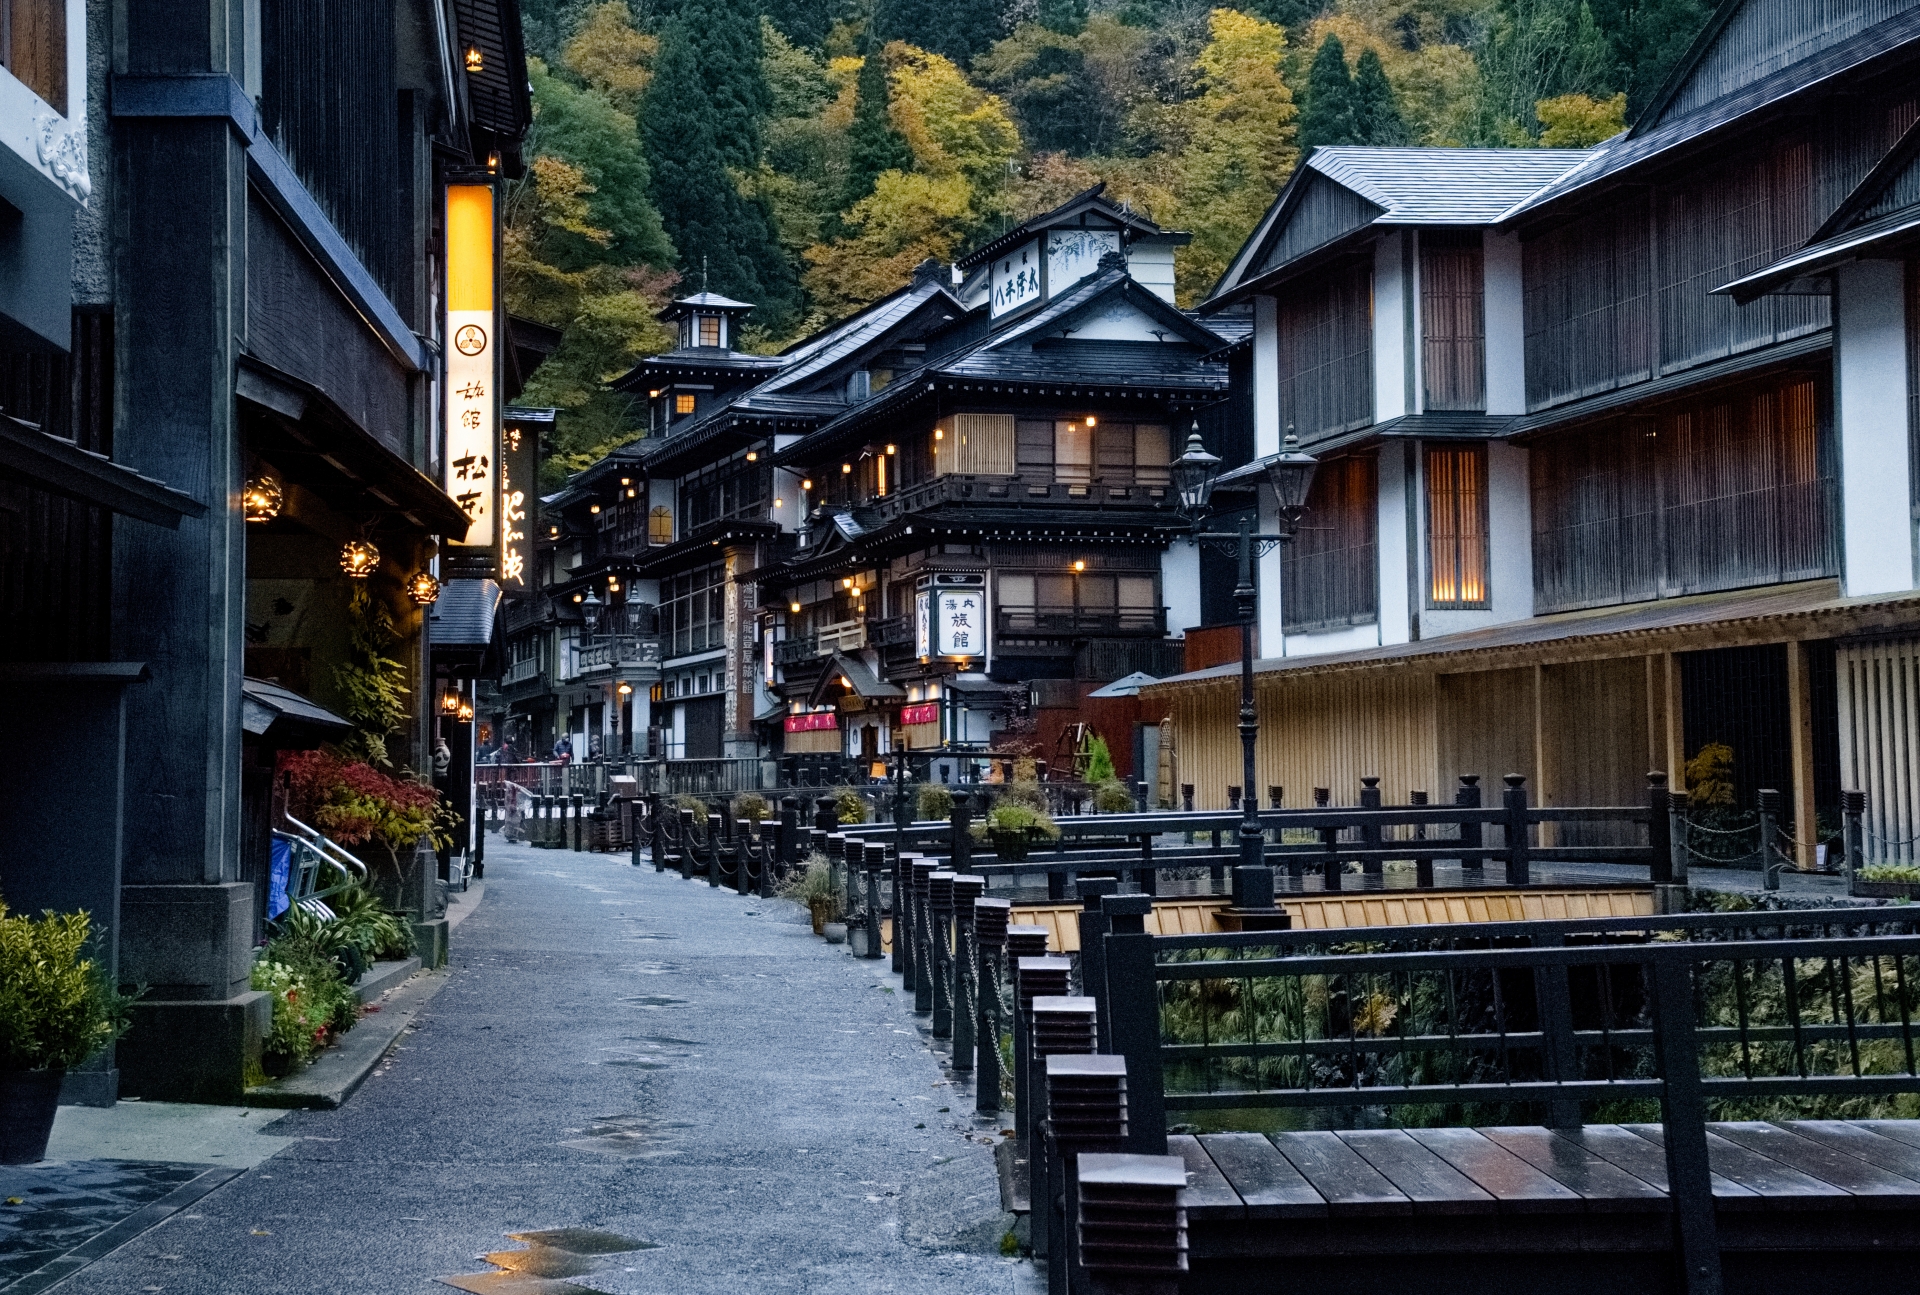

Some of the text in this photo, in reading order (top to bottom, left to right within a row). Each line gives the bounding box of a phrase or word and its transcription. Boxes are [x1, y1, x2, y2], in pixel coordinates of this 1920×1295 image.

[456, 380, 485, 430] 旅館
[951, 612, 972, 649] 旅館
[742, 619, 753, 694] 能登屋旅館
